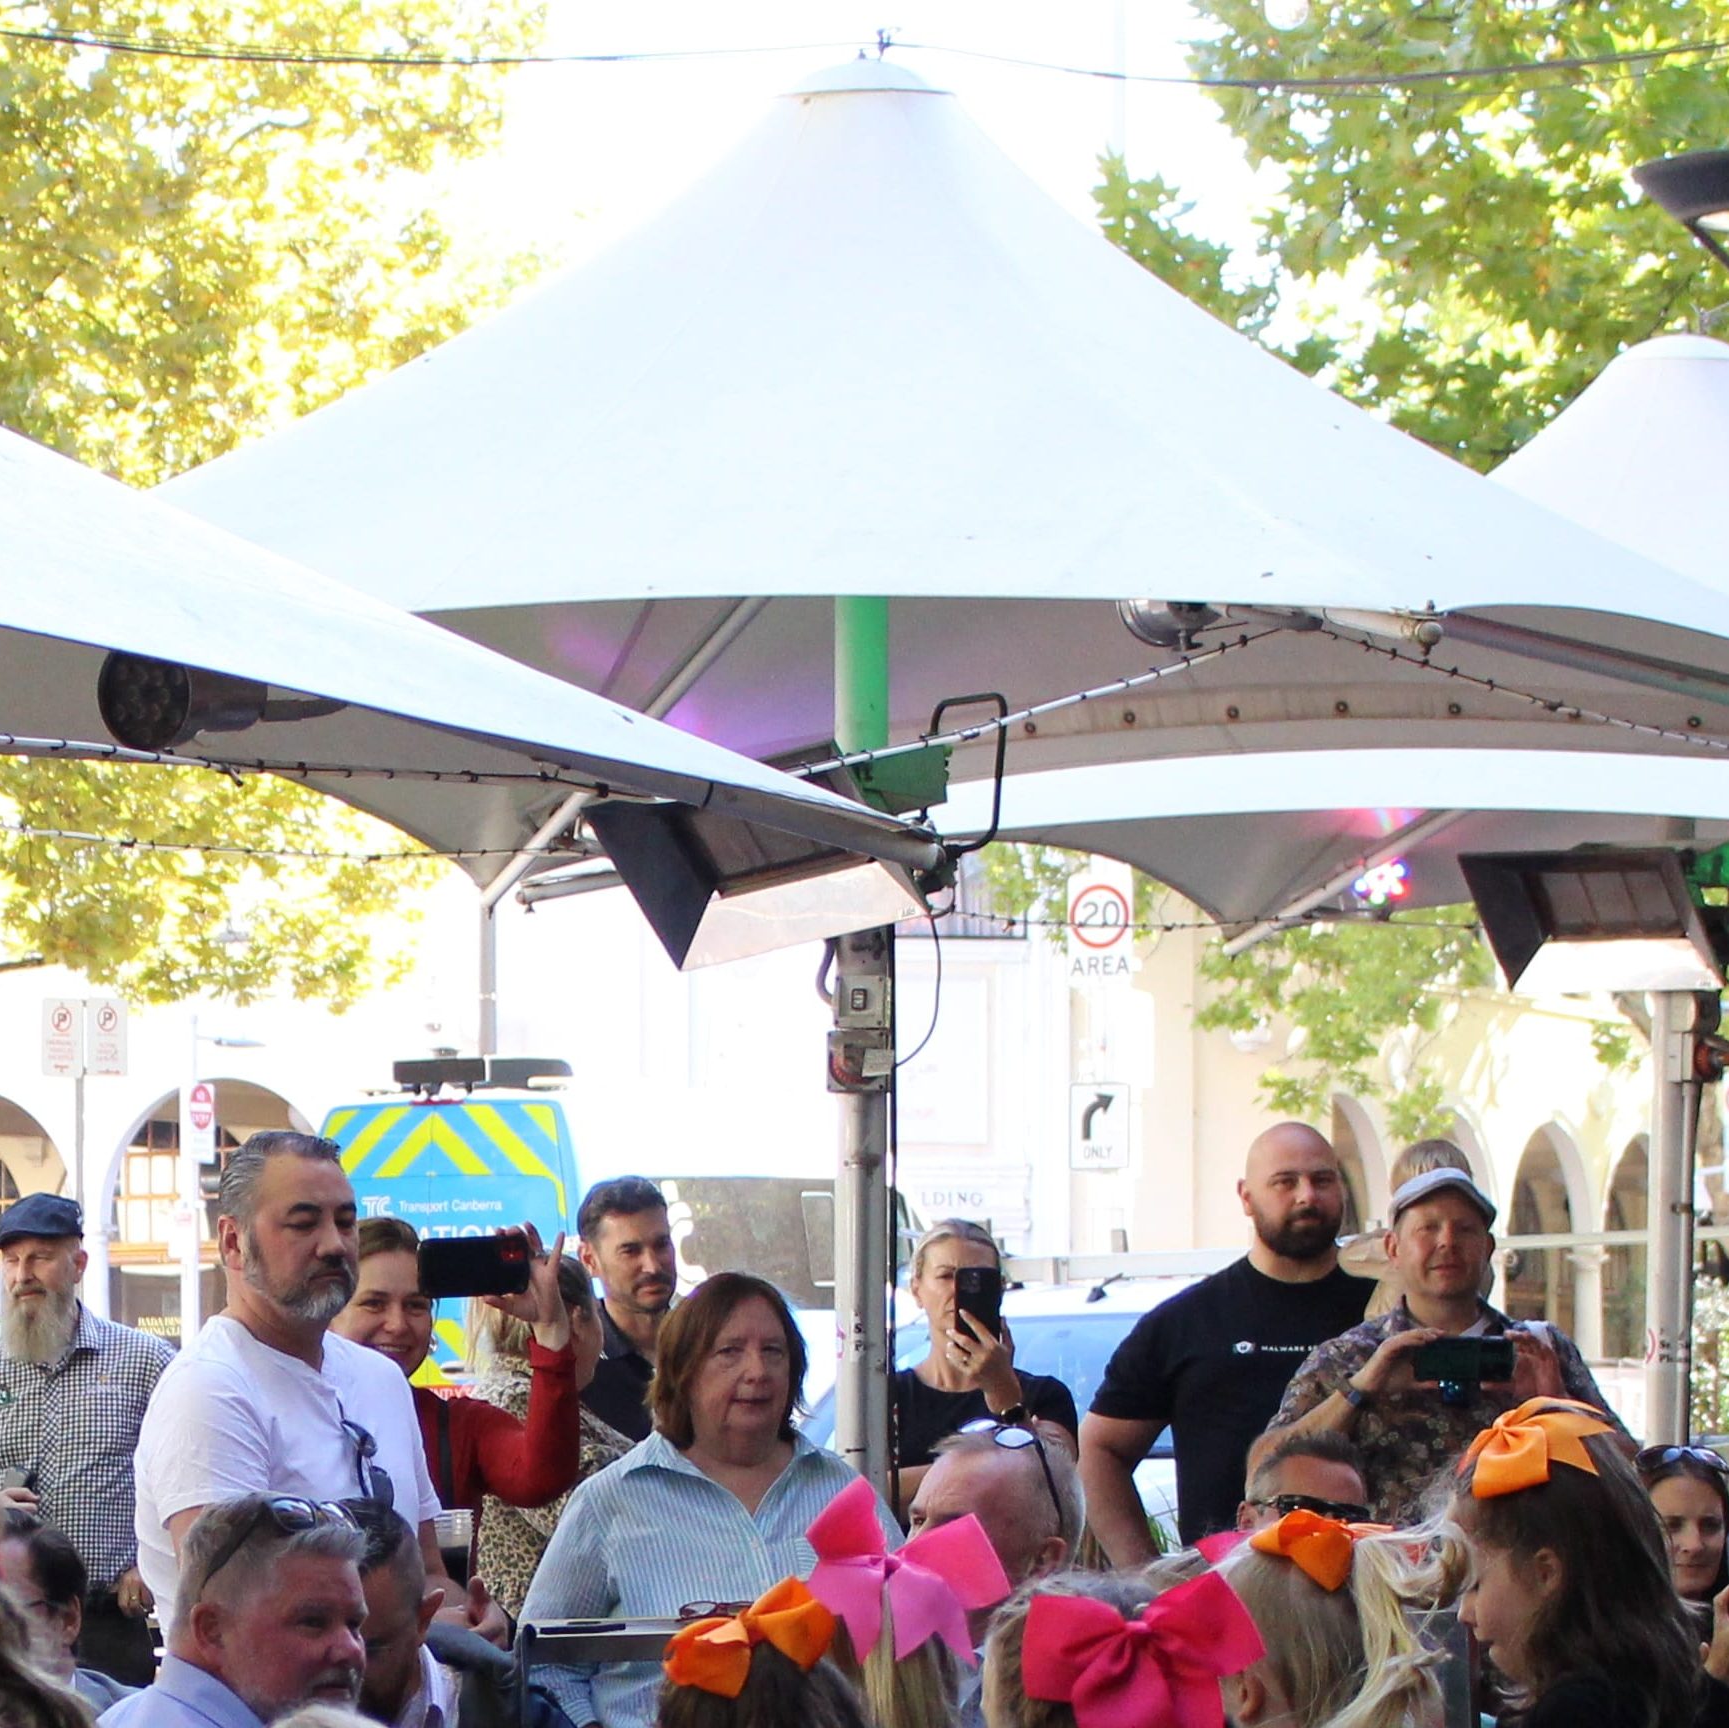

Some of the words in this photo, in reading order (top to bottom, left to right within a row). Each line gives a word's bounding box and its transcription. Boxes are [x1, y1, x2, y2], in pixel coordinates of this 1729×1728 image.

[1082, 900, 1120, 927] 20
[1070, 956, 1130, 976] AREA
[1083, 1146, 1113, 1160] ONLY
[399, 1201, 448, 1214] Transport
[451, 1199, 503, 1212] Canberra
